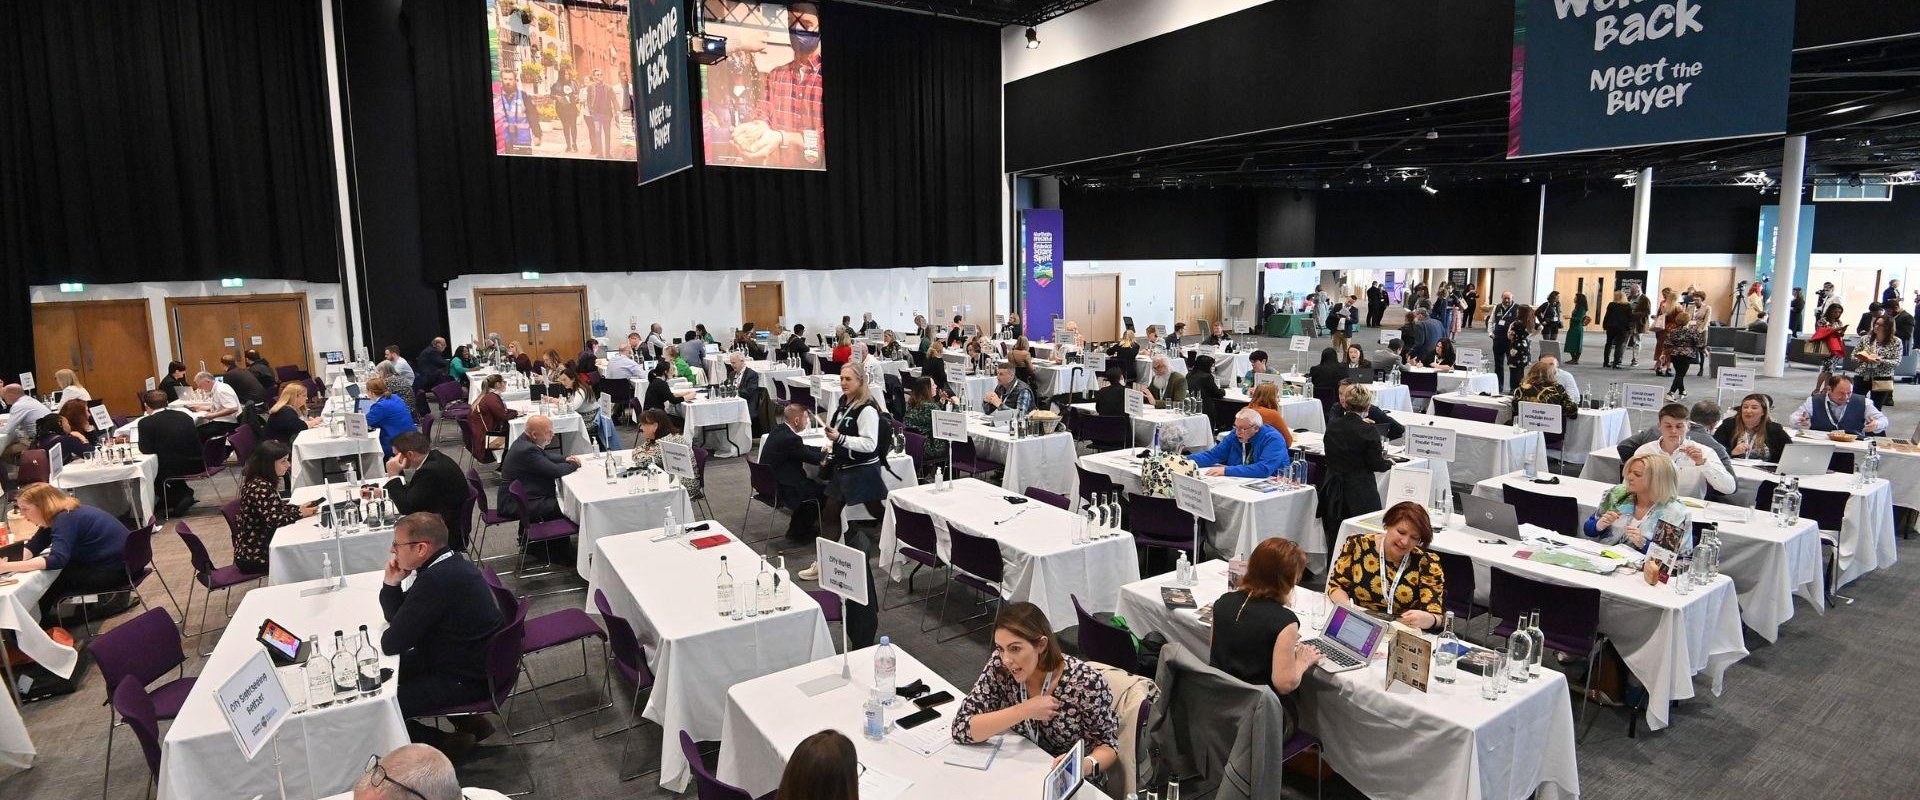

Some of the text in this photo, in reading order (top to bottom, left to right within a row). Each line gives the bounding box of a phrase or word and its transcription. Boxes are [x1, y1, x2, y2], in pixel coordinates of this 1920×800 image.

[636, 6, 678, 67] Welcome
[1594, 0, 1703, 51] Back
[647, 48, 670, 94] Back
[1590, 57, 1703, 92] Meet the
[649, 100, 665, 129] Meet
[1606, 82, 1692, 115] Buyer
[653, 122, 671, 150] Buyer
[829, 555, 852, 569] City Hotel
[230, 701, 240, 712] City
[239, 673, 267, 703] Sightseeing
[246, 692, 265, 715] Belfast
